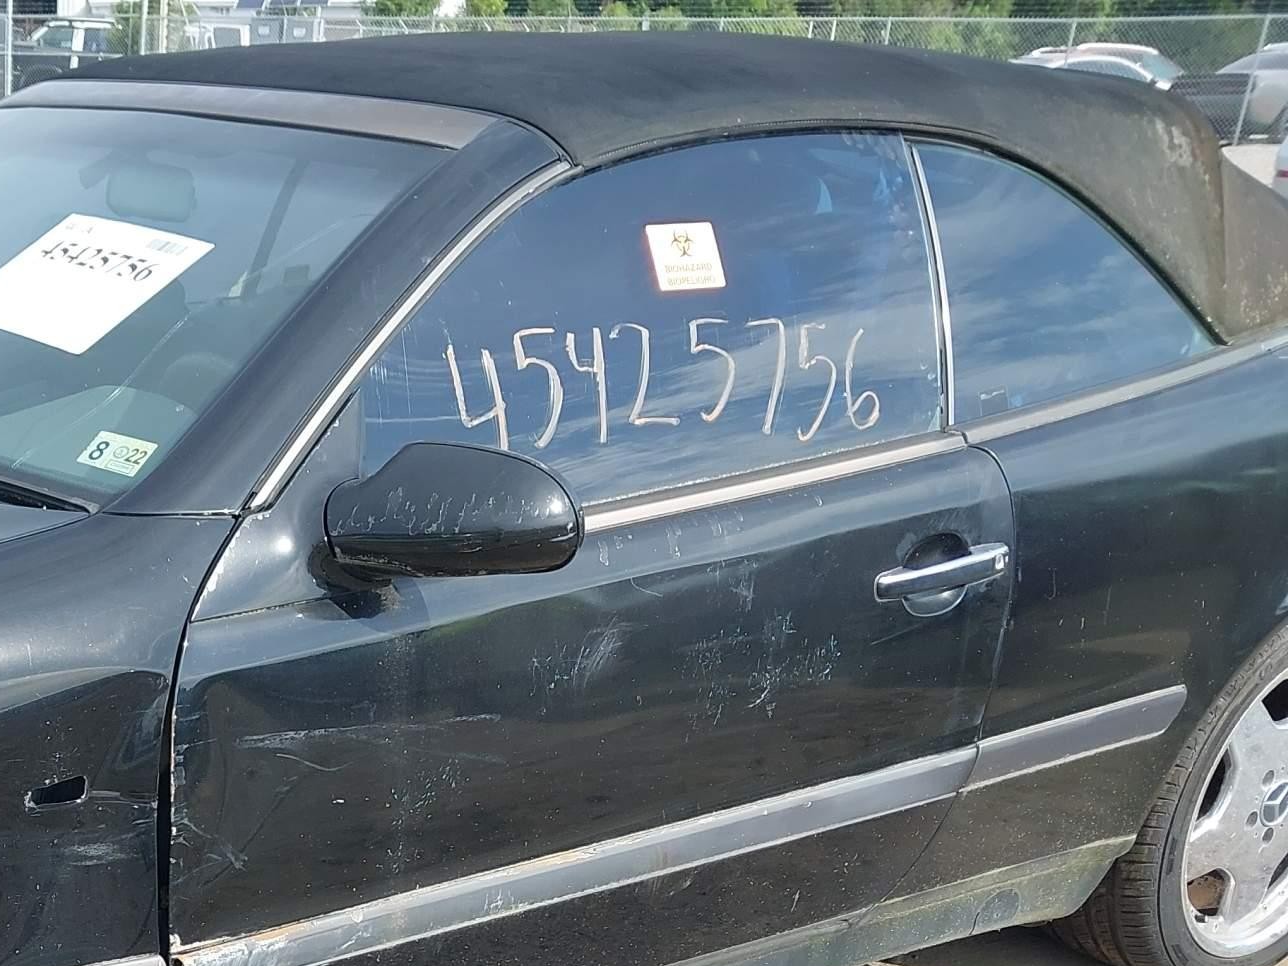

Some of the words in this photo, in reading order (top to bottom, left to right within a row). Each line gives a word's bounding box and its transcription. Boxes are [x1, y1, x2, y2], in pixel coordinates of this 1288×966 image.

[41, 240, 160, 282] 45425756
[664, 262, 713, 273] BIOHAZARD
[442, 317, 881, 450] 45425756
[88, 440, 110, 461] 8
[123, 447, 148, 465] 22
